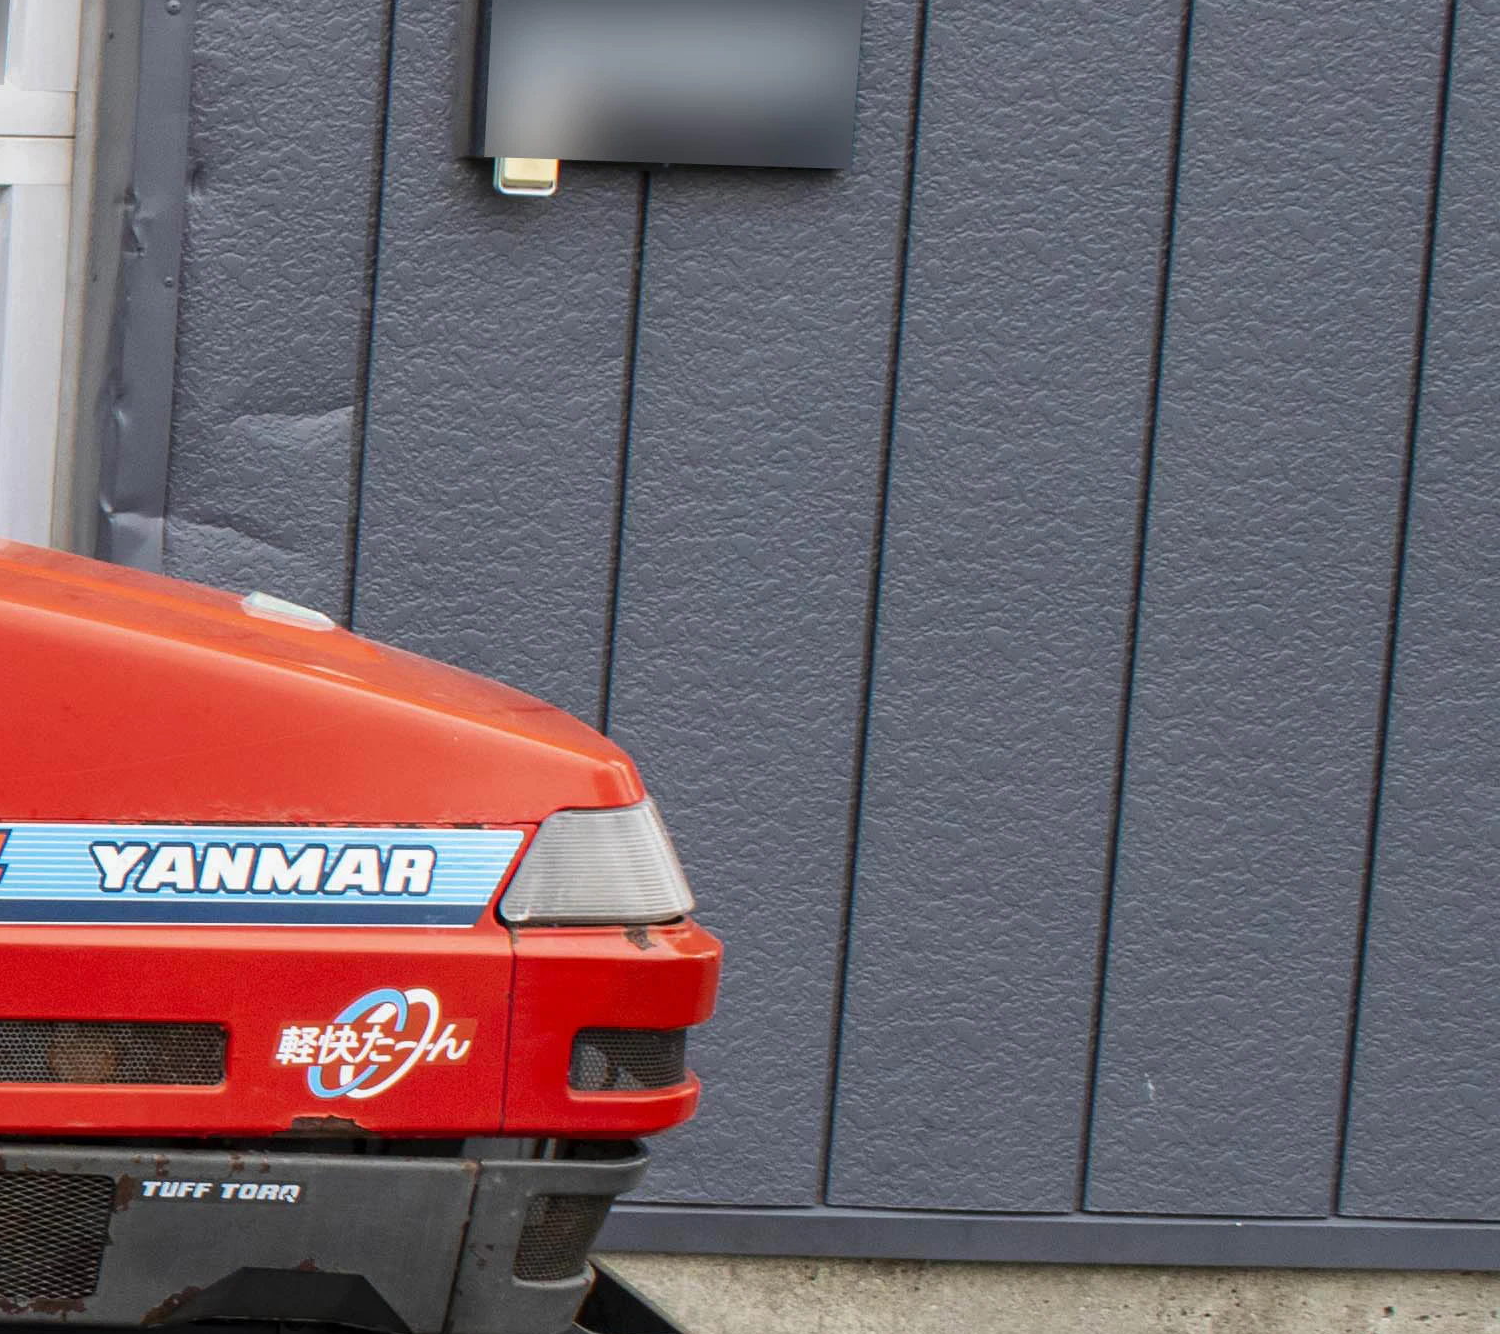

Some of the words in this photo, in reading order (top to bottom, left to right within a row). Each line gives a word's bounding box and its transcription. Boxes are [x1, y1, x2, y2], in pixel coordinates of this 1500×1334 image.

[91, 841, 436, 897] YANMAR
[142, 1181, 212, 1199] TUFF
[220, 1181, 301, 1204] TORQ
